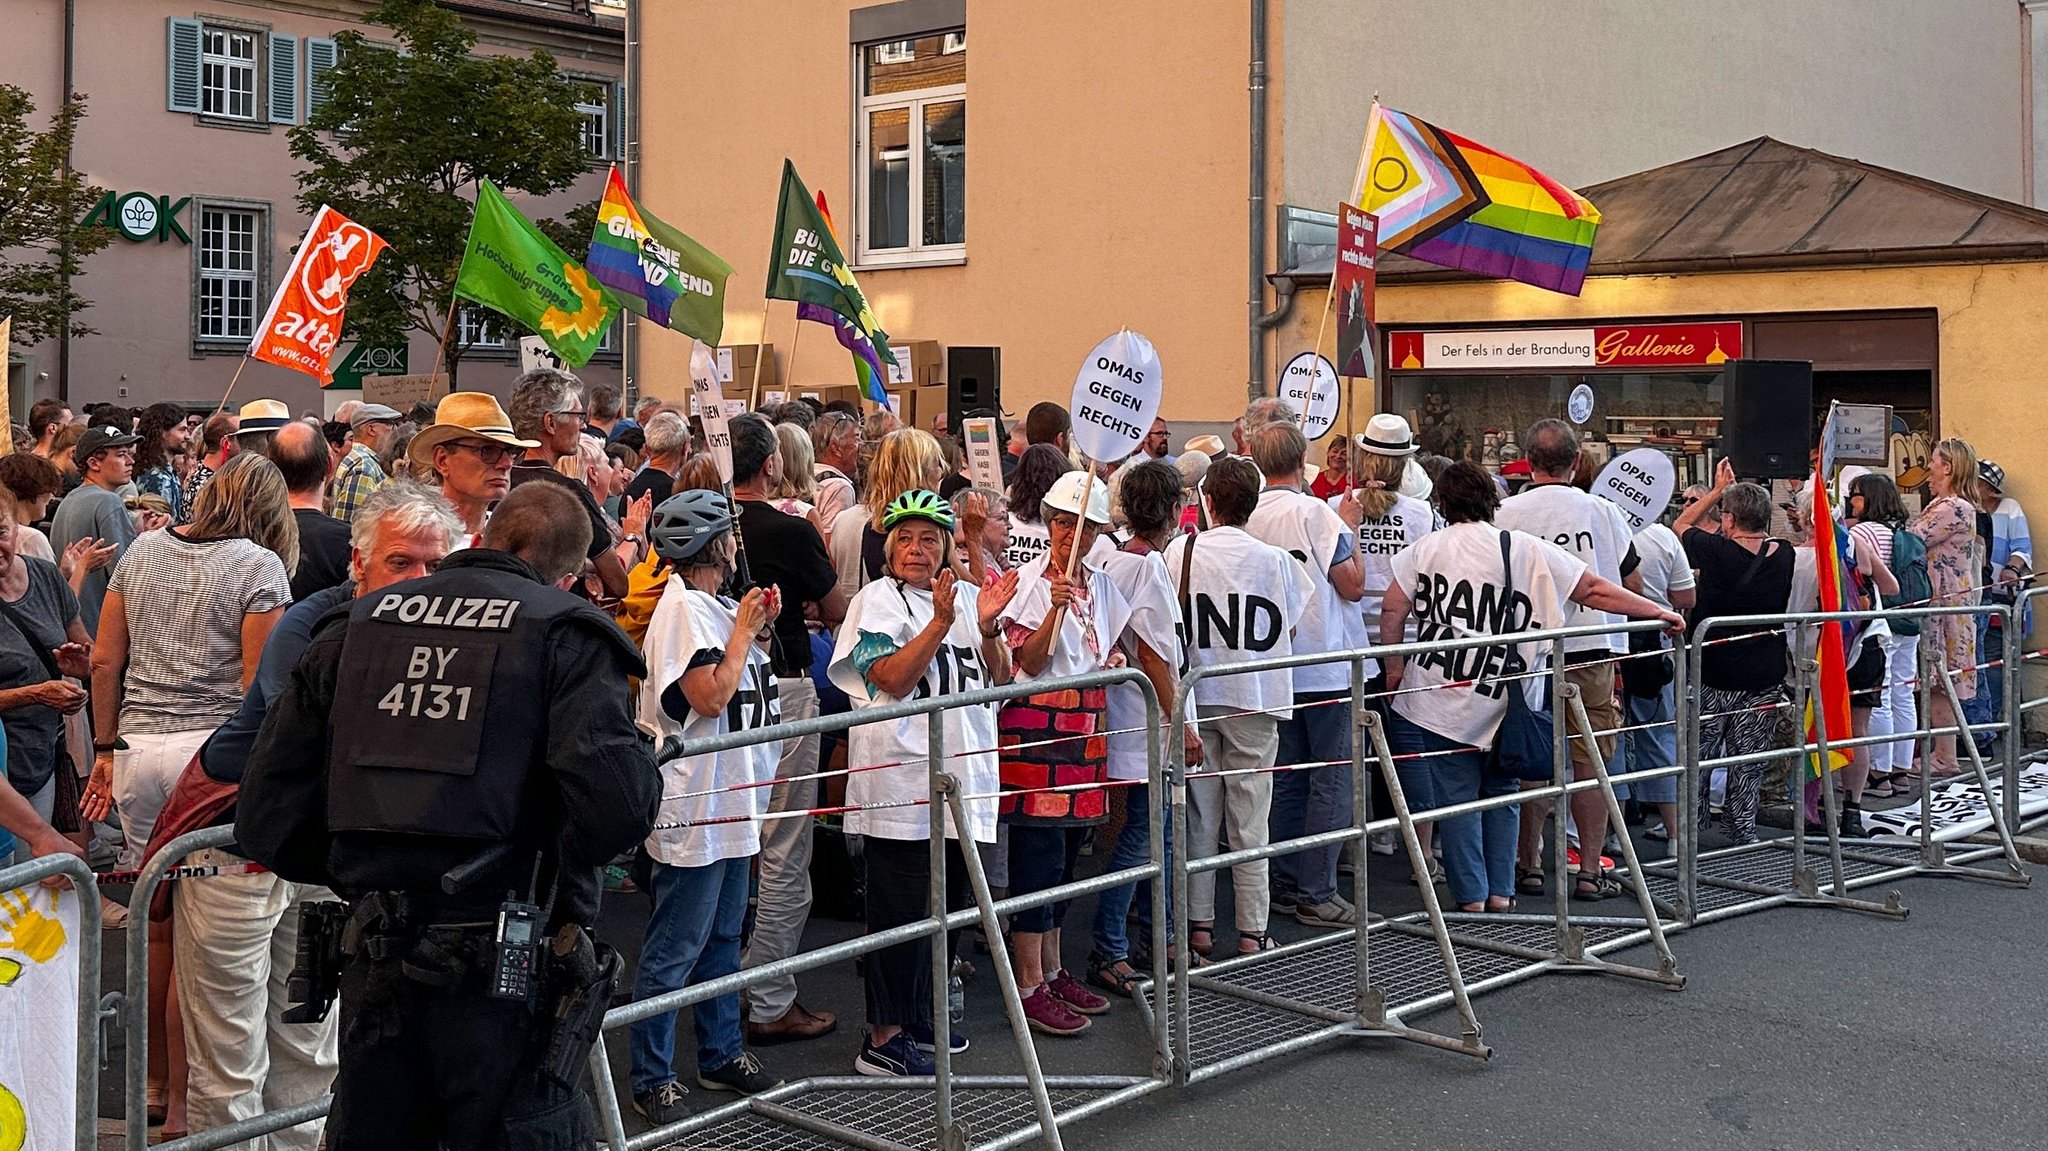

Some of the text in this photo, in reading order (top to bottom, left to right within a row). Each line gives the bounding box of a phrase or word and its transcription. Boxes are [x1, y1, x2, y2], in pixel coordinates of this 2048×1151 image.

[80, 190, 193, 244] AOK
[788, 248, 817, 268] DIE
[474, 241, 569, 308] Hochschulgruppe
[353, 347, 404, 368] AOK
[1441, 342, 1590, 357] Der Fels in der Brandung
[1595, 329, 1695, 365] Gallerie
[1097, 357, 1144, 384] OMAS
[1089, 381, 1142, 412] GEGEN
[1079, 405, 1142, 440] RECHTS
[1620, 461, 1655, 486] OPAS
[1608, 477, 1652, 507] GEGEN
[1360, 529, 1405, 541] EGEN
[371, 594, 520, 628] POLIZEI
[407, 646, 459, 680] BY
[378, 683, 472, 721] 4131
